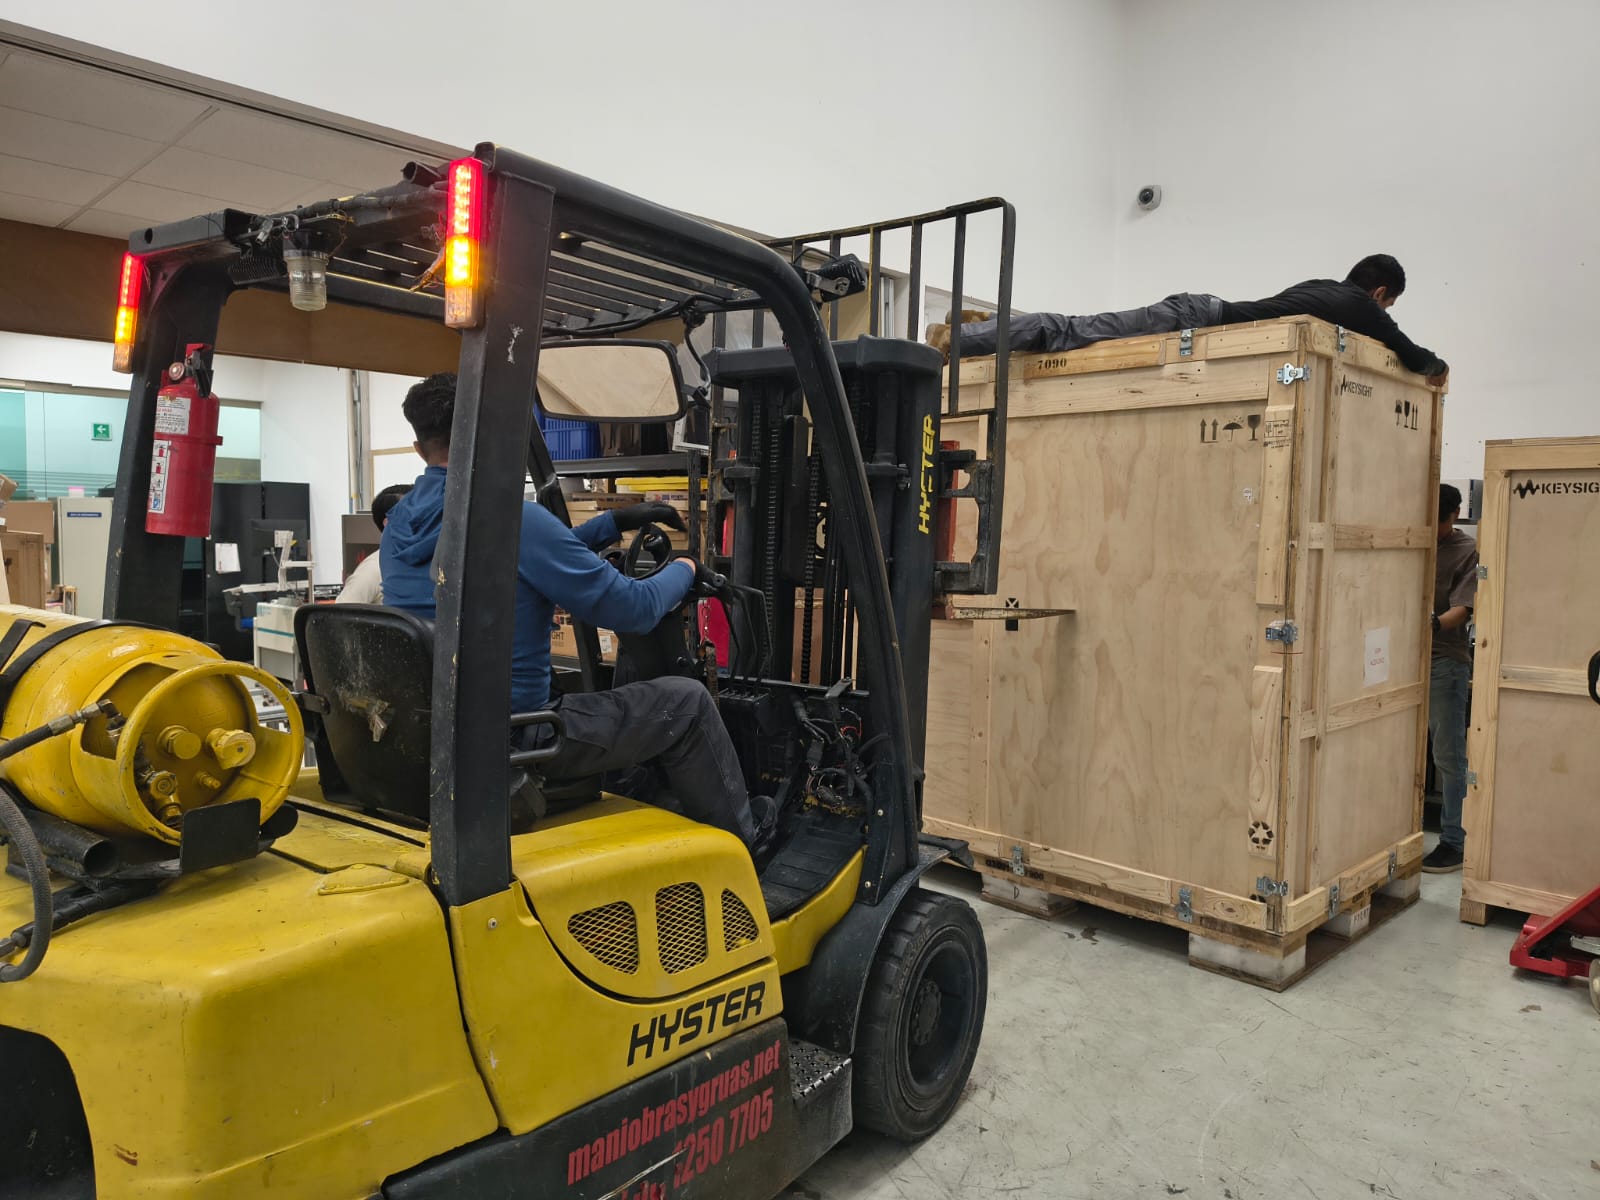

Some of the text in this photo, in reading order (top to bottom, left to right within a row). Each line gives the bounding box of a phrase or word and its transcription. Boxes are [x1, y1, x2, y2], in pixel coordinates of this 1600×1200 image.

[1037, 358, 1067, 370] 7090
[1347, 381, 1373, 397] KEYSIGHT
[918, 414, 936, 535] HYSTER
[627, 981, 766, 1067] HYSTER
[567, 1039, 782, 1186] maniobrasygruas.net
[729, 1088, 774, 1156] 7705
